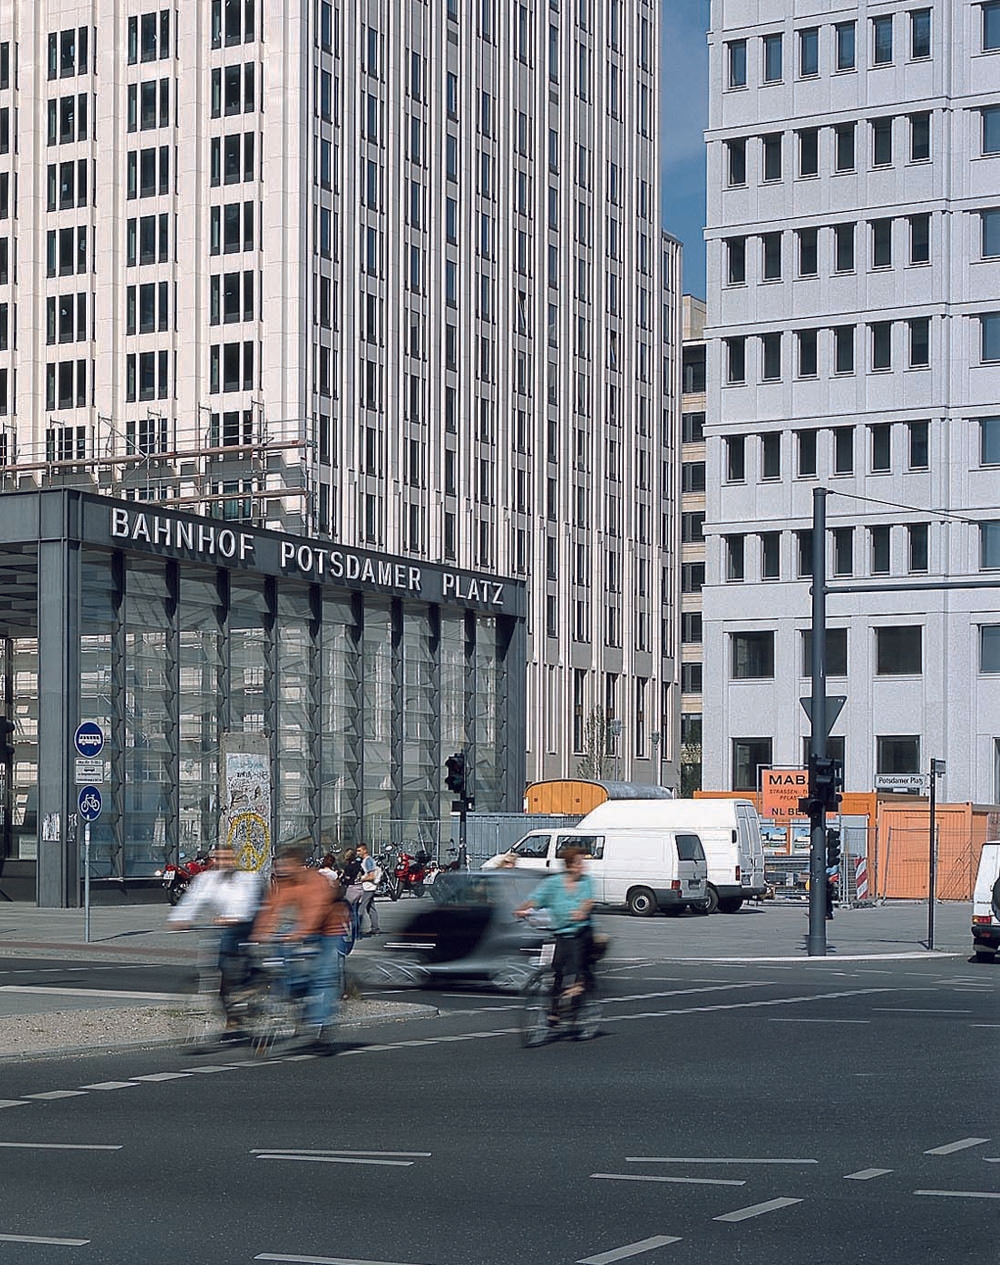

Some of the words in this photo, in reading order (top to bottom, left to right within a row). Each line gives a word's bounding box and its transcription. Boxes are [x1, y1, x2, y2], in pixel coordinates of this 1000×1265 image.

[112, 507, 255, 559] BAHNHOF
[281, 541, 422, 591] POTSDAMER
[442, 572, 505, 606] PLATZ
[769, 775, 809, 785] MAB
[771, 808, 785, 816] NL
